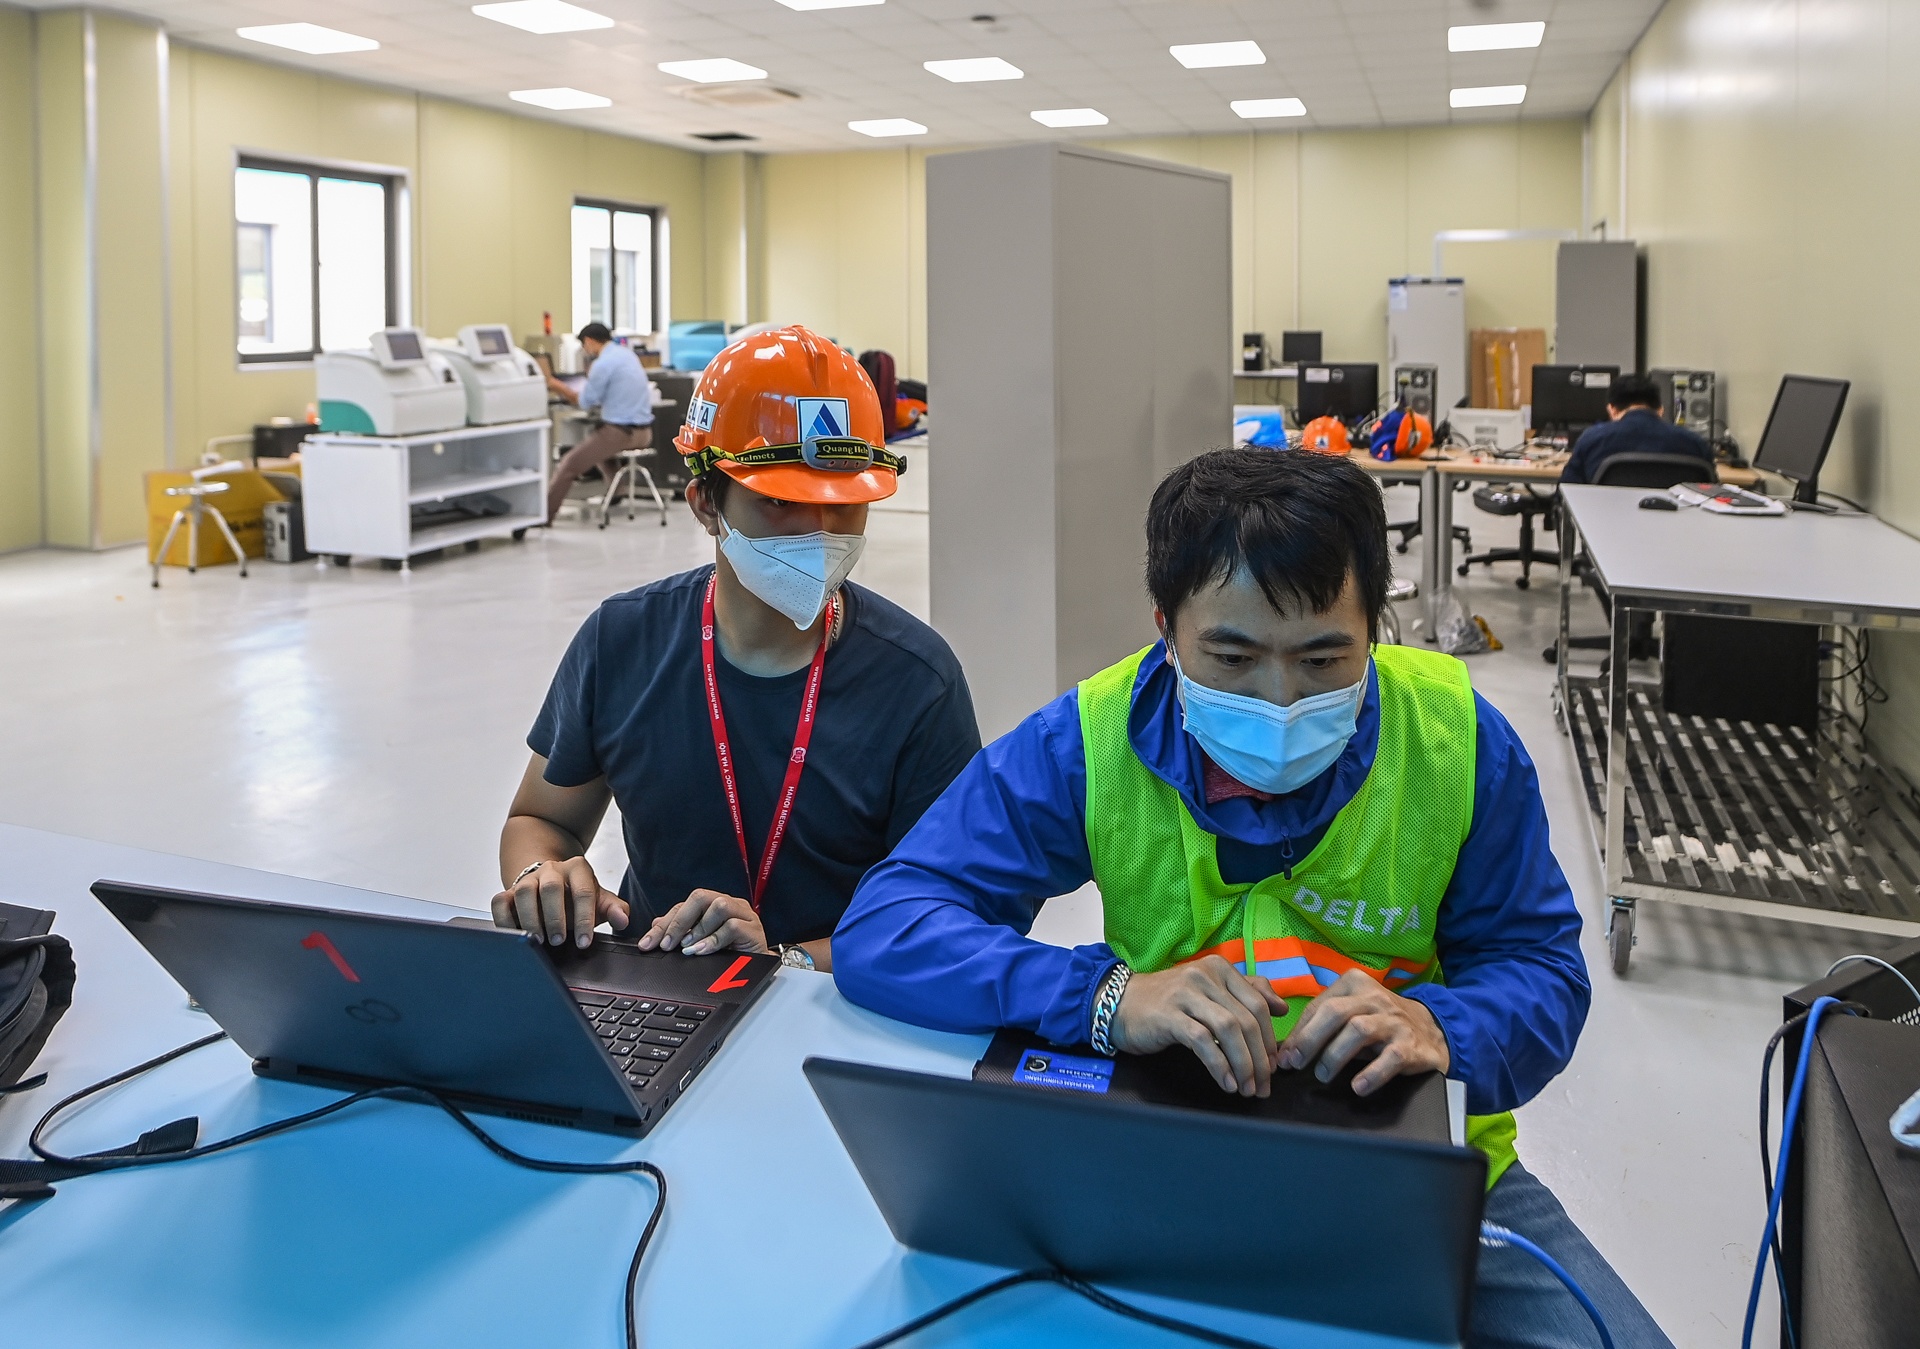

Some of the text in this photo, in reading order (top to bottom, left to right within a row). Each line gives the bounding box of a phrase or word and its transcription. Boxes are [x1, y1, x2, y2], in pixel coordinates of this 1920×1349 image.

[822, 444, 853, 455] Quang
[706, 663, 719, 720] www.hmu.edu.vn
[804, 666, 819, 722] www.hmu.edu.vn
[762, 786, 795, 880] HANOI MEDICAL UNIVERSITY
[1292, 885, 1421, 937] DELTA
